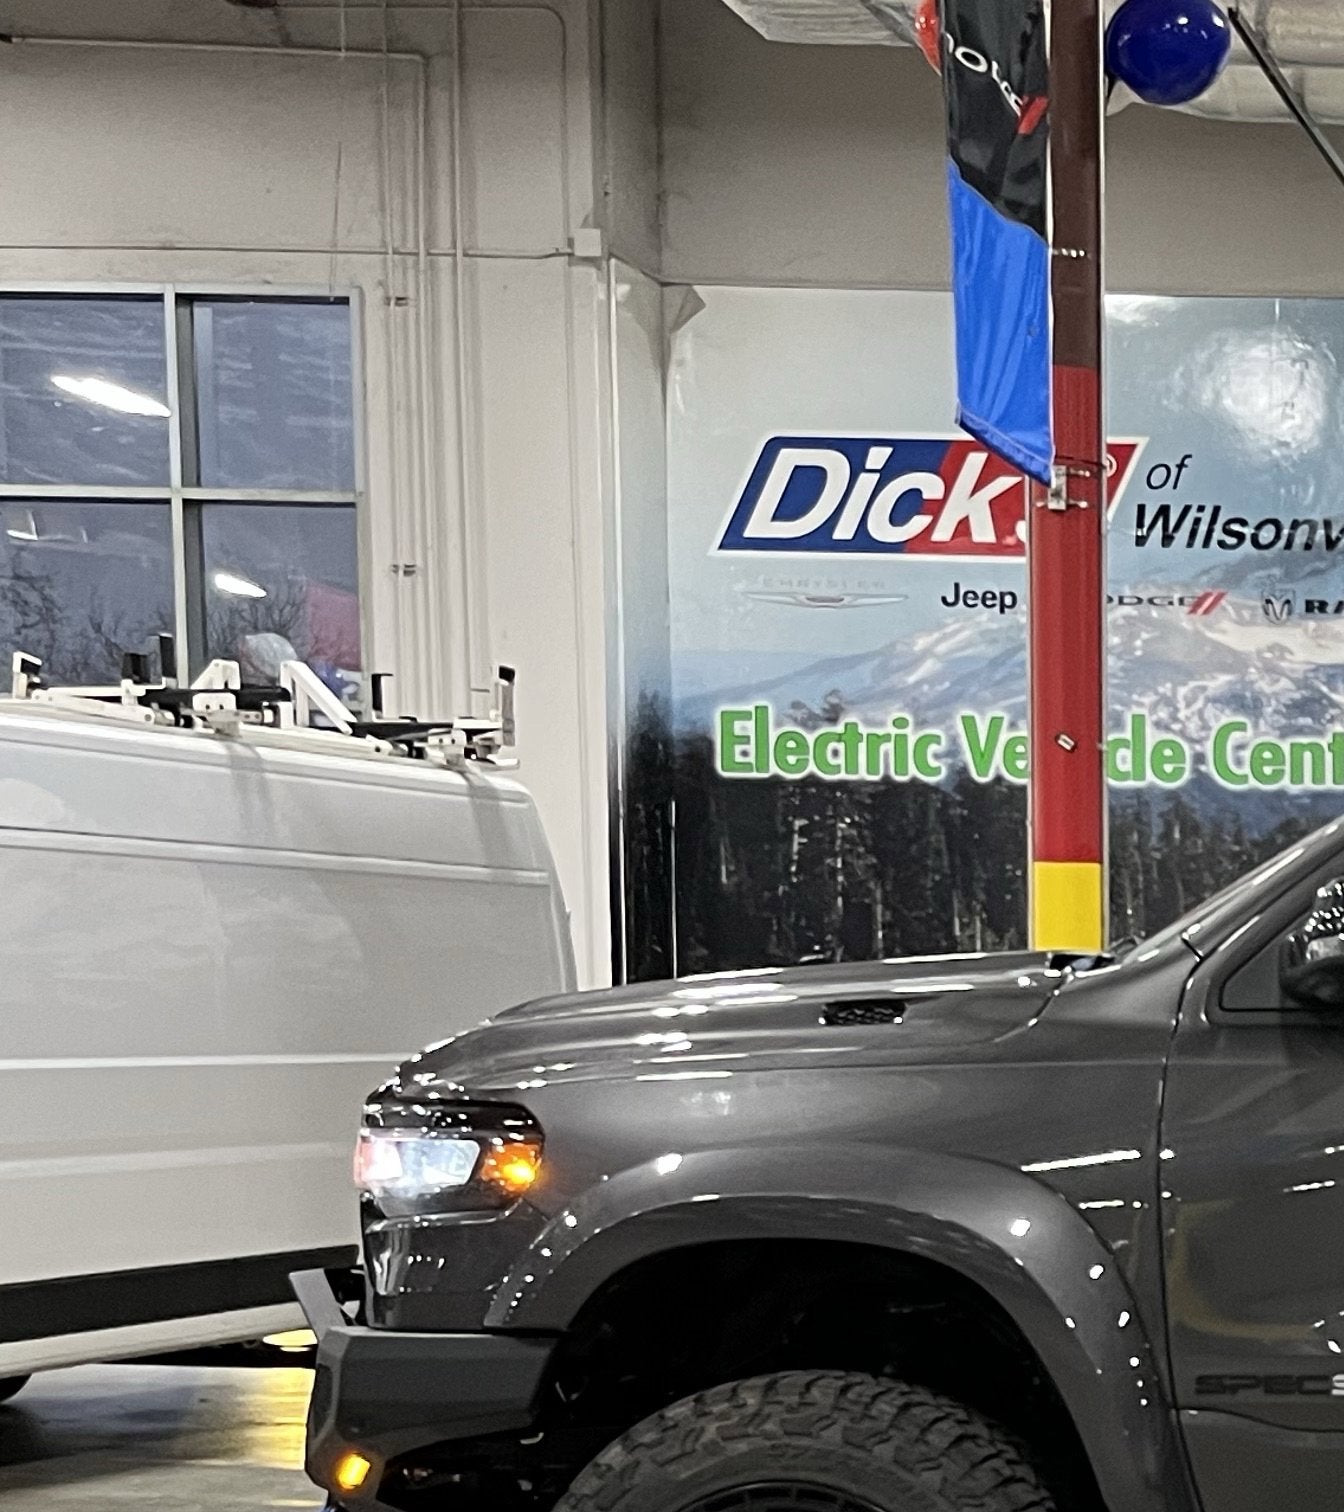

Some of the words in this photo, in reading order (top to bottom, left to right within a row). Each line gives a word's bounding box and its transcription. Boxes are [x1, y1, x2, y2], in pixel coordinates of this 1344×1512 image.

[1145, 453, 1193, 491] of
[742, 446, 1026, 544] Dick
[940, 582, 1018, 614] Jeep
[1106, 594, 1200, 607] DGE
[719, 705, 943, 777] Electric
[961, 713, 1187, 784] Vecle
